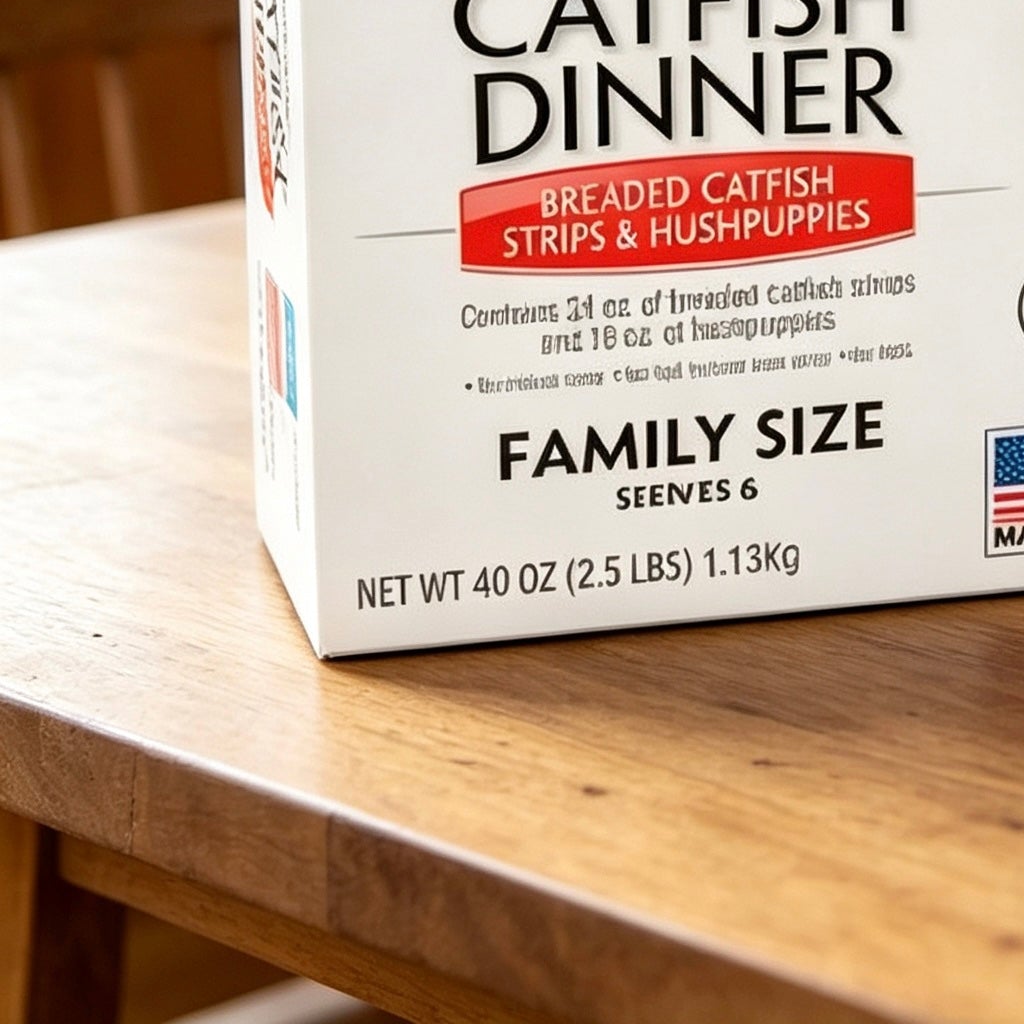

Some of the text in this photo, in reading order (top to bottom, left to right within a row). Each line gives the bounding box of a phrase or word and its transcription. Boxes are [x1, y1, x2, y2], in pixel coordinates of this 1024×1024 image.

[474, 48, 903, 165] DINNER
[540, 165, 834, 217] BREADED CATFISH
[503, 199, 870, 258] STRIPS & HUSHPUPPIES
[500, 401, 883, 480] FAMILY SIZE
[740, 477, 758, 500] 6
[358, 543, 799, 609] NET WT 40 OZ (2.5 LBS) 1.13Kg
